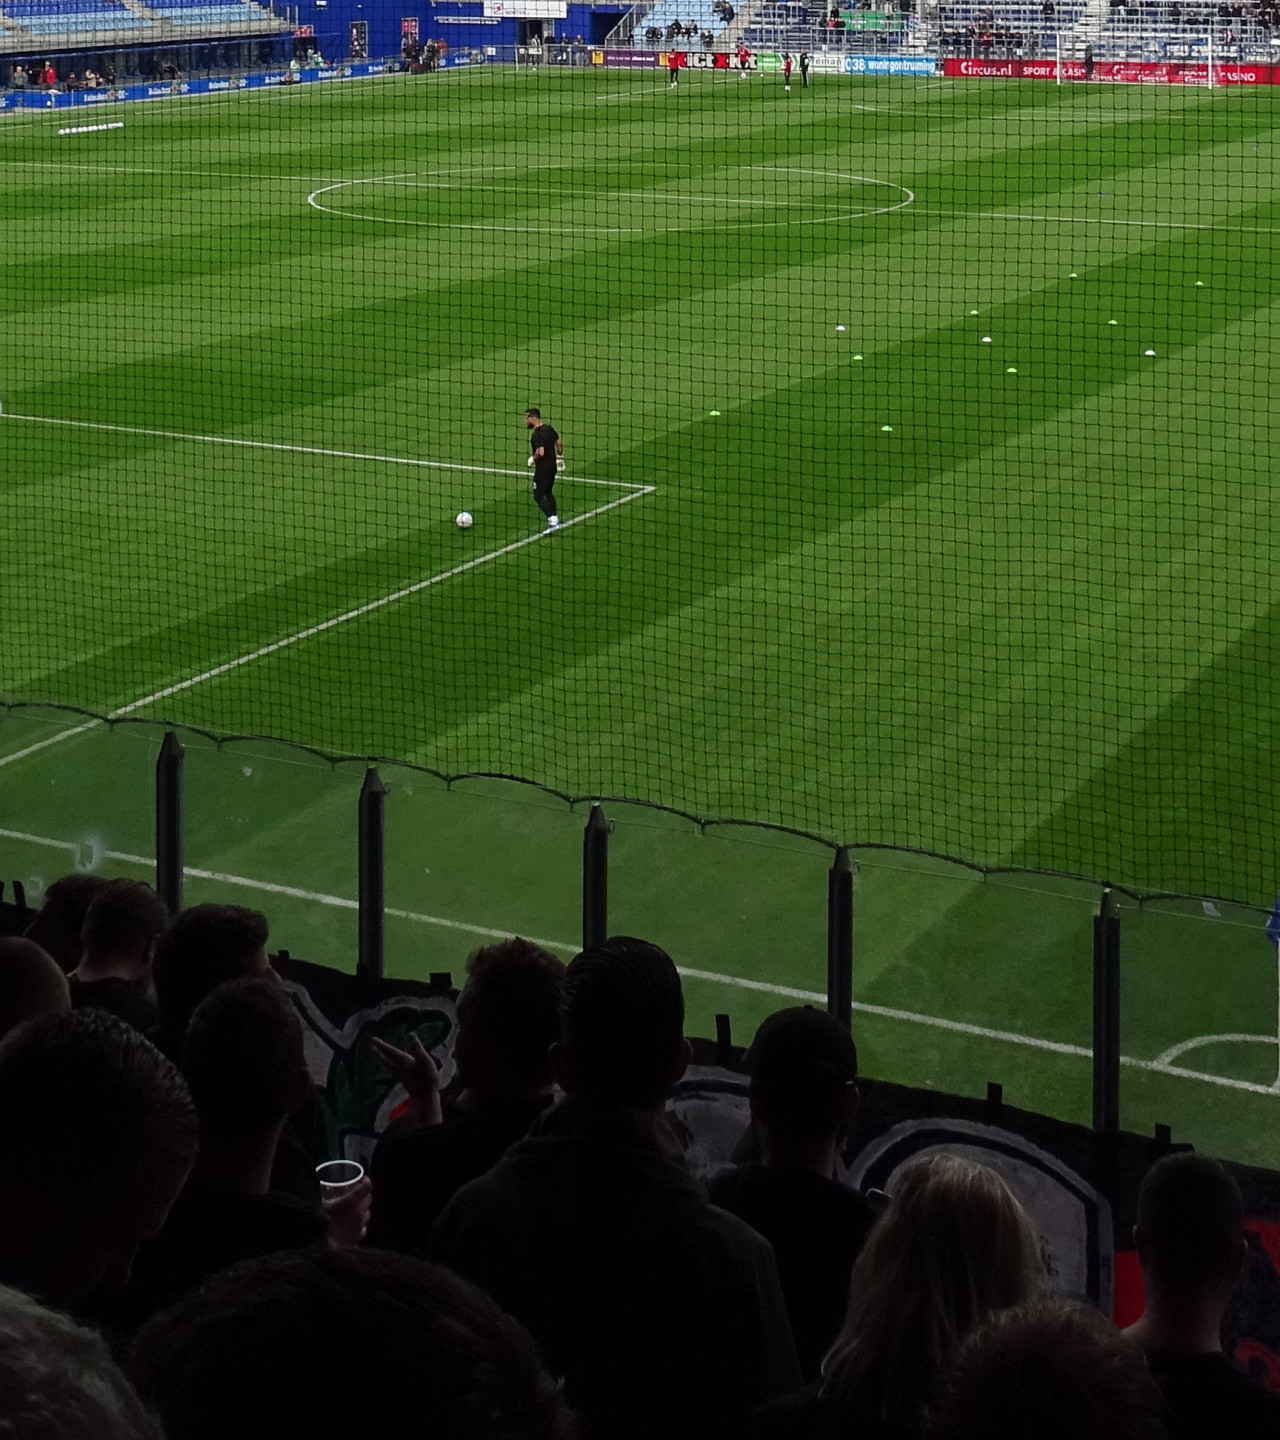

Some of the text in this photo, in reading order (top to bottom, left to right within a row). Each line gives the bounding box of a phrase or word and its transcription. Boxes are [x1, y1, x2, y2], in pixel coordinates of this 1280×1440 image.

[1167, 45, 1189, 56] FEU
[960, 61, 1012, 76] Circus.nl
[1023, 66, 1050, 75] SPORT
